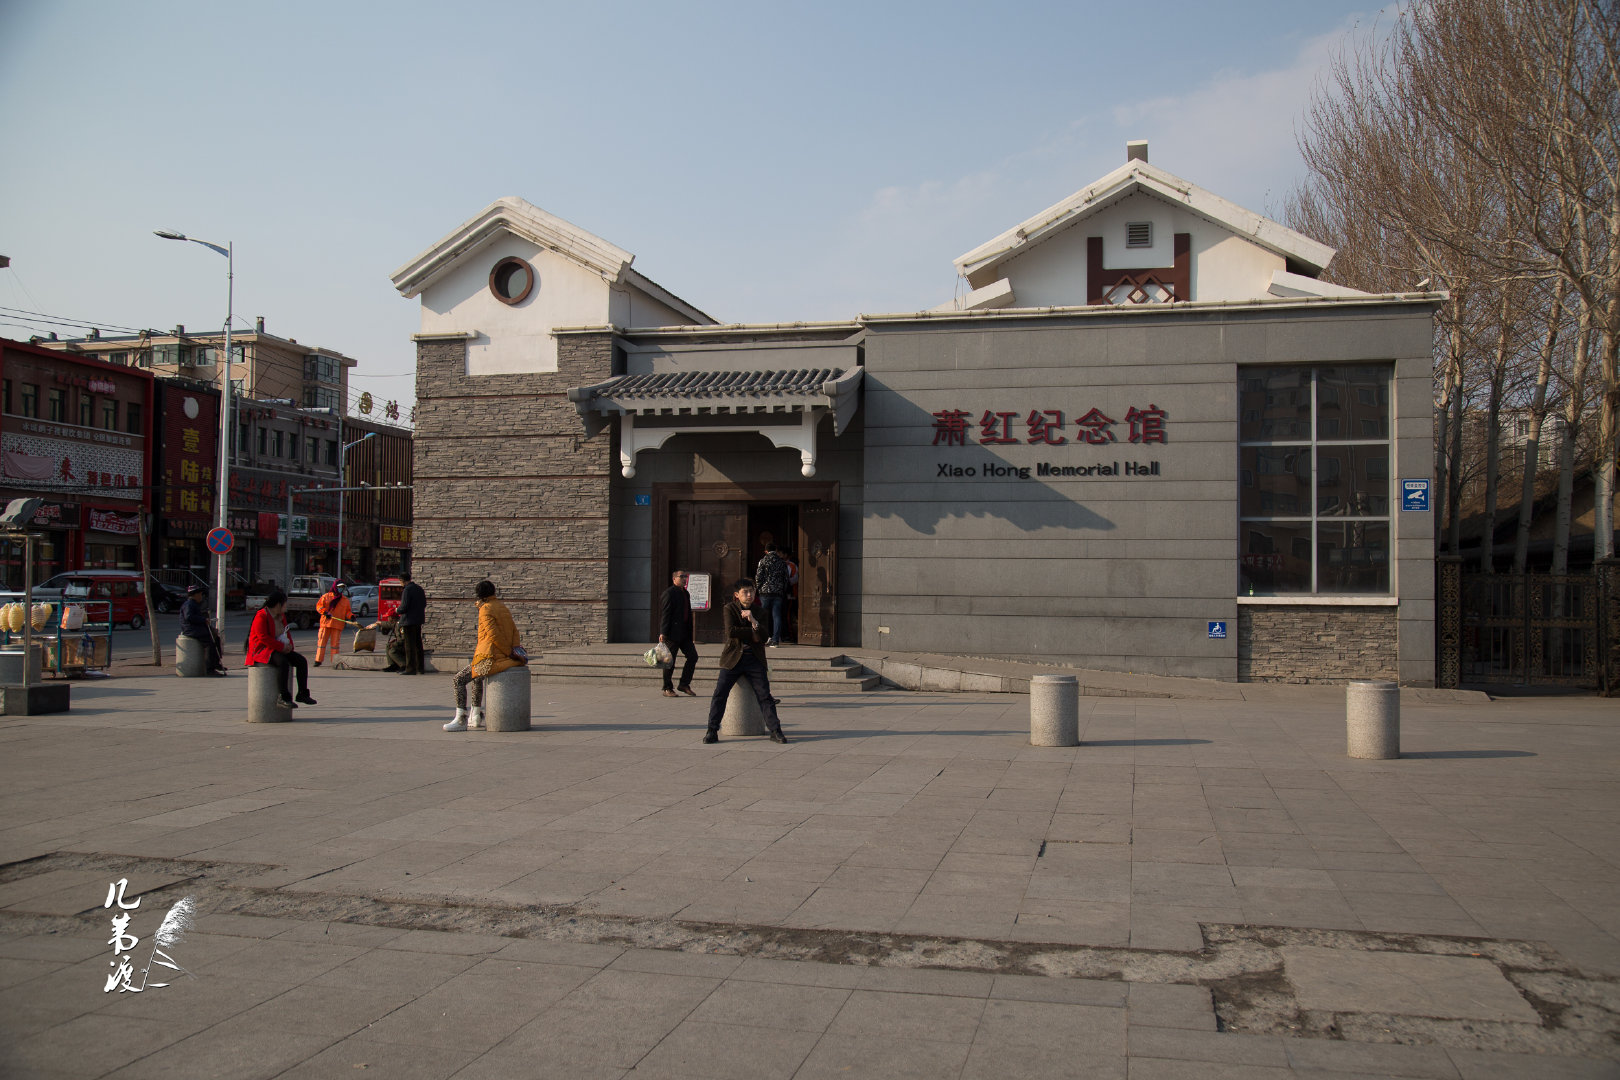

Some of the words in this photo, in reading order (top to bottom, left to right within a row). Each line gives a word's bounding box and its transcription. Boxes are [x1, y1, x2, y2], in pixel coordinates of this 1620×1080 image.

[931, 403, 1167, 446] 萧红纪念馆
[180, 428, 200, 512] 壹陆陆
[937, 463, 976, 477] Xiao
[983, 463, 1030, 479] Hong
[1036, 462, 1119, 476] Memorial
[1124, 461, 1160, 476] Hall
